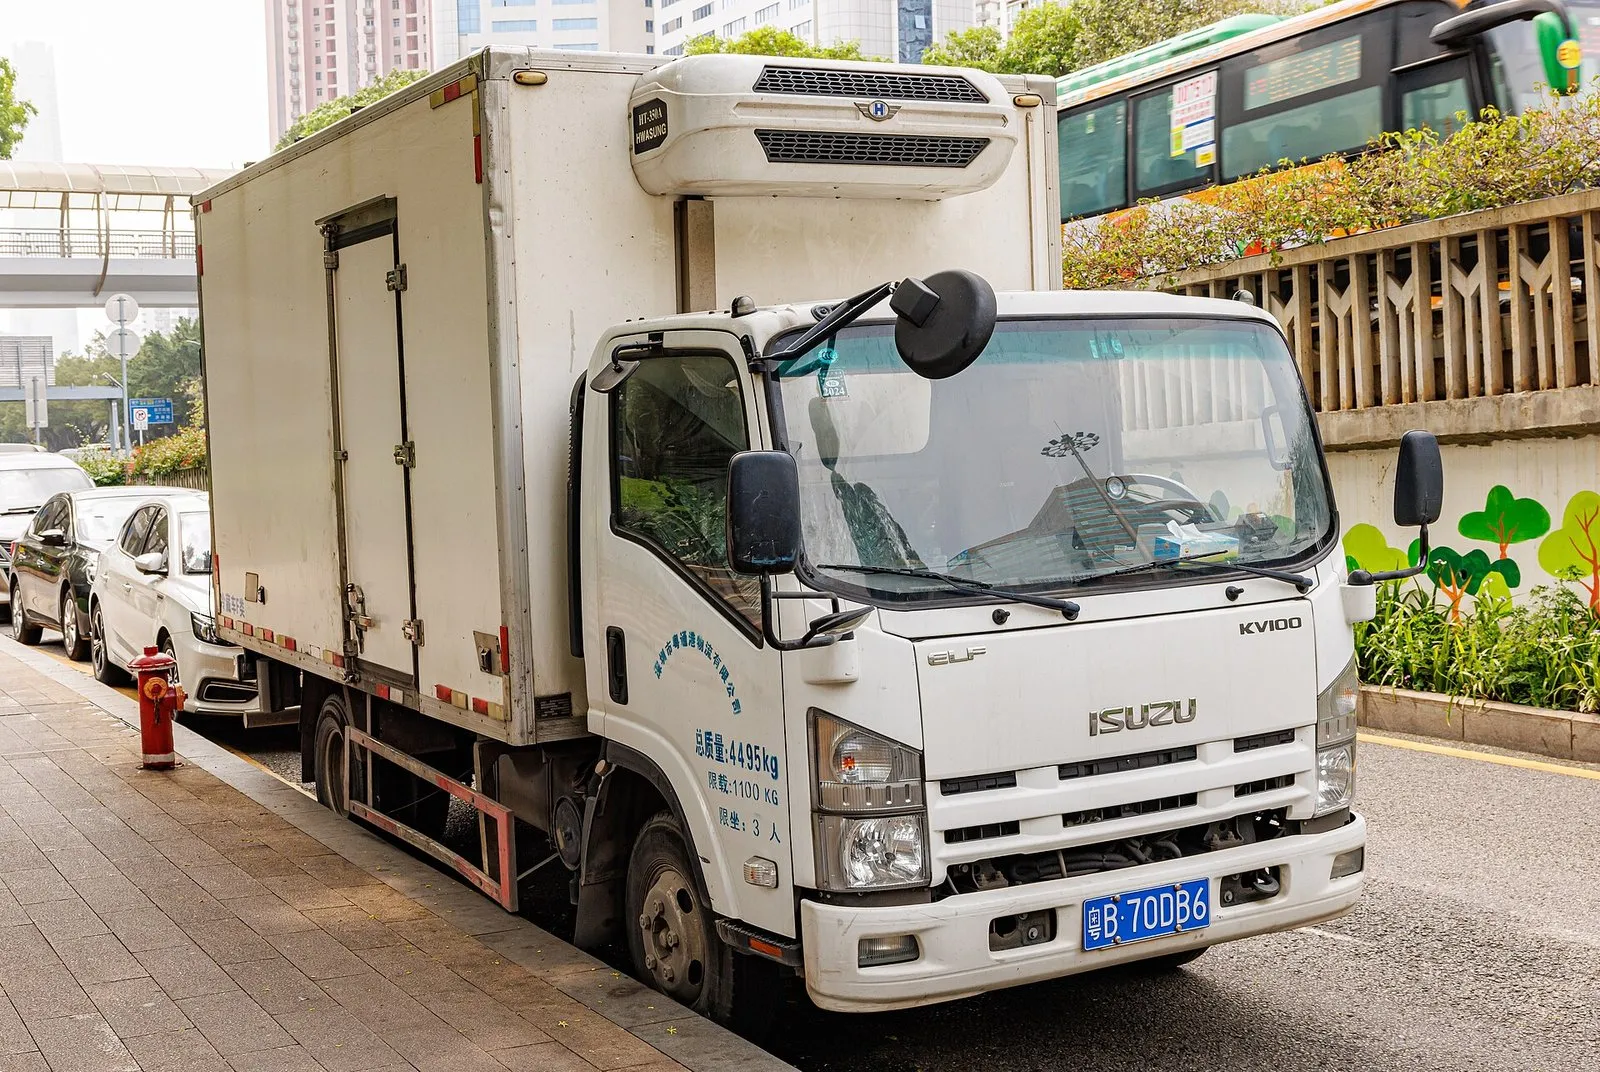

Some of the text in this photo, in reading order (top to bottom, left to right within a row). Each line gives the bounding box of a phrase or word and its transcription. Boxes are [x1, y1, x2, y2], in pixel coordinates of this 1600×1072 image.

[874, 102, 885, 116] H
[635, 123, 667, 145] HWASUNG
[823, 386, 846, 397] 2024
[1239, 616, 1302, 635] KV100
[927, 646, 987, 666] ELF
[1089, 697, 1197, 737] ISUZU
[764, 787, 779, 806] KG
[752, 818, 760, 837] 3
[769, 822, 781, 844] 人
